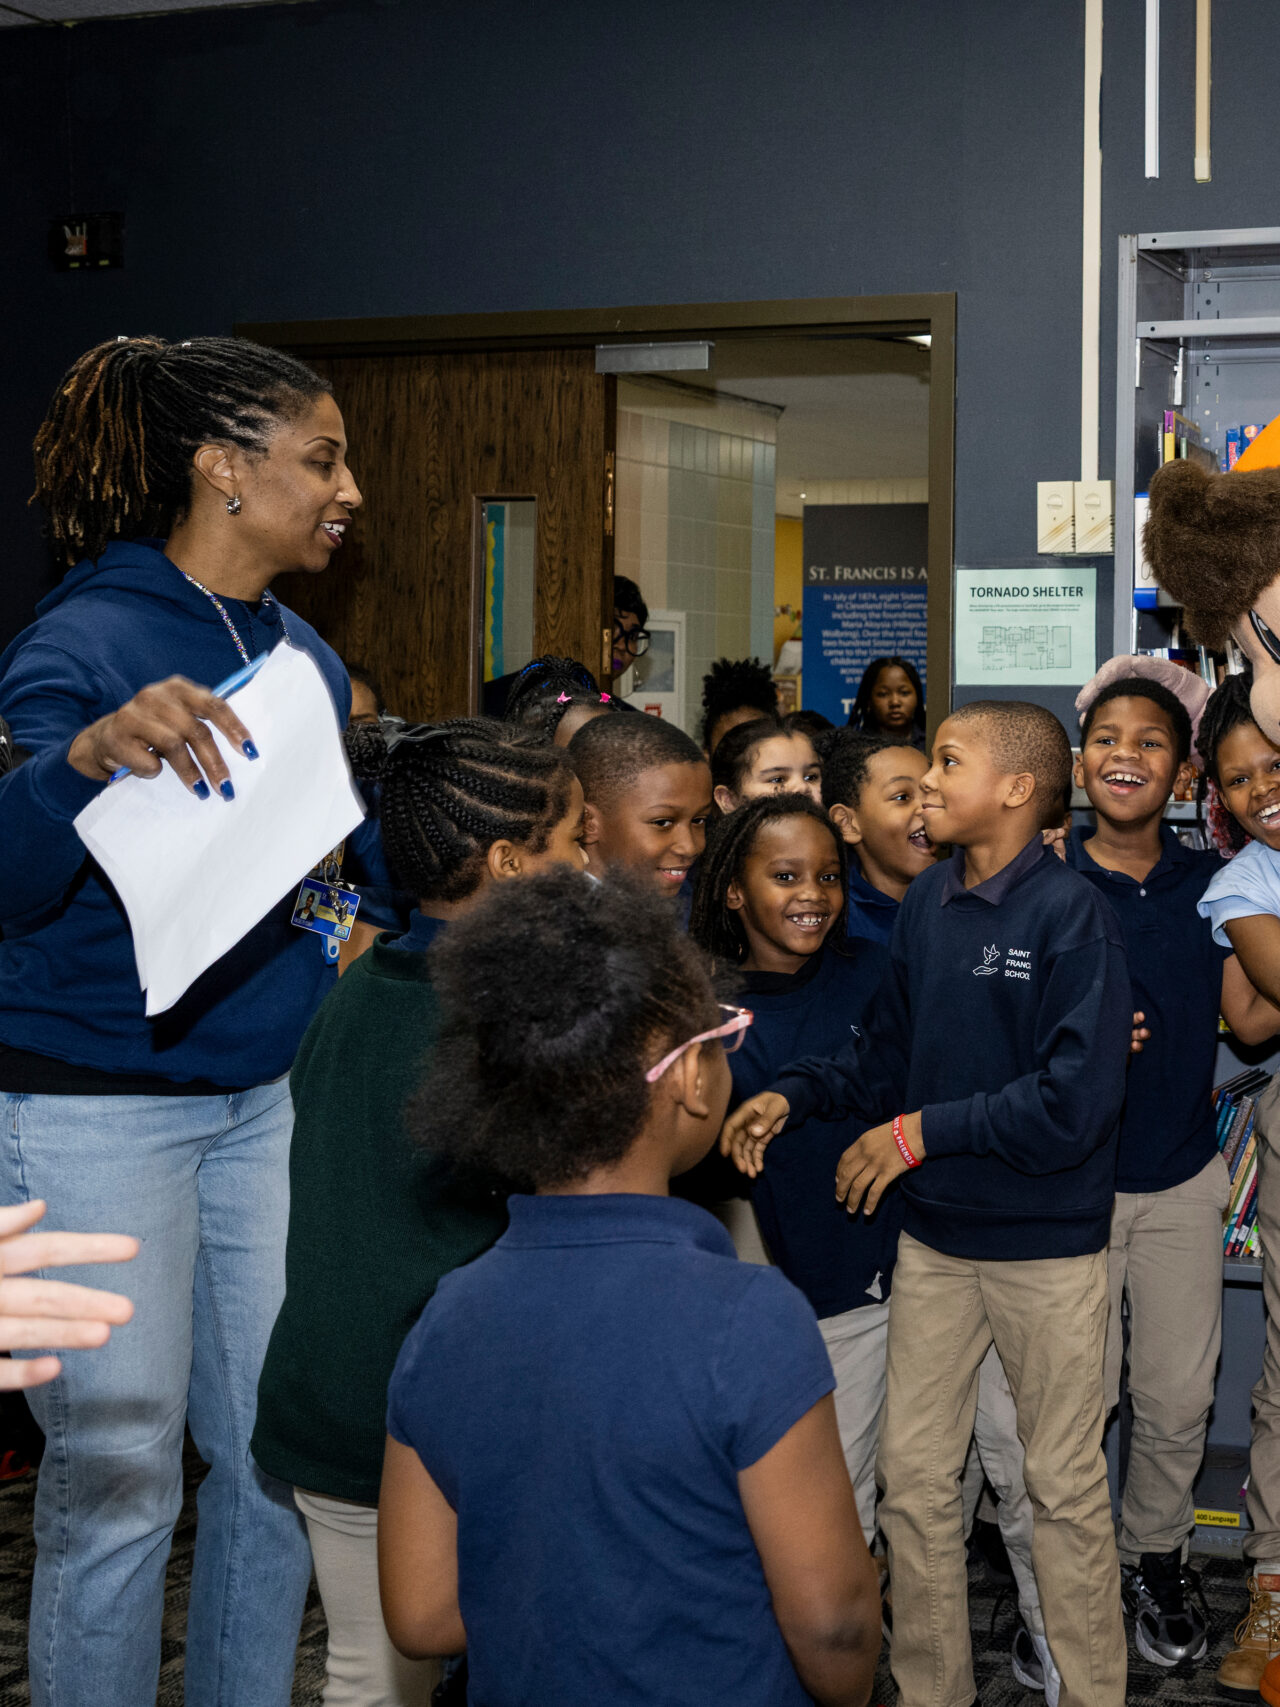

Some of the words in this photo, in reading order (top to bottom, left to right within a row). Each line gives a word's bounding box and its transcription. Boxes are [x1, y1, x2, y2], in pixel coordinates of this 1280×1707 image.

[834, 566, 897, 580] FRANCIS
[901, 567, 915, 580] IS
[970, 587, 1029, 598] TORNADO
[1033, 586, 1084, 597] SHELTER
[845, 602, 882, 610] Cleveland
[838, 639, 871, 647] hundred
[1008, 948, 1031, 958] SAINT
[1208, 1514, 1238, 1524] Language
